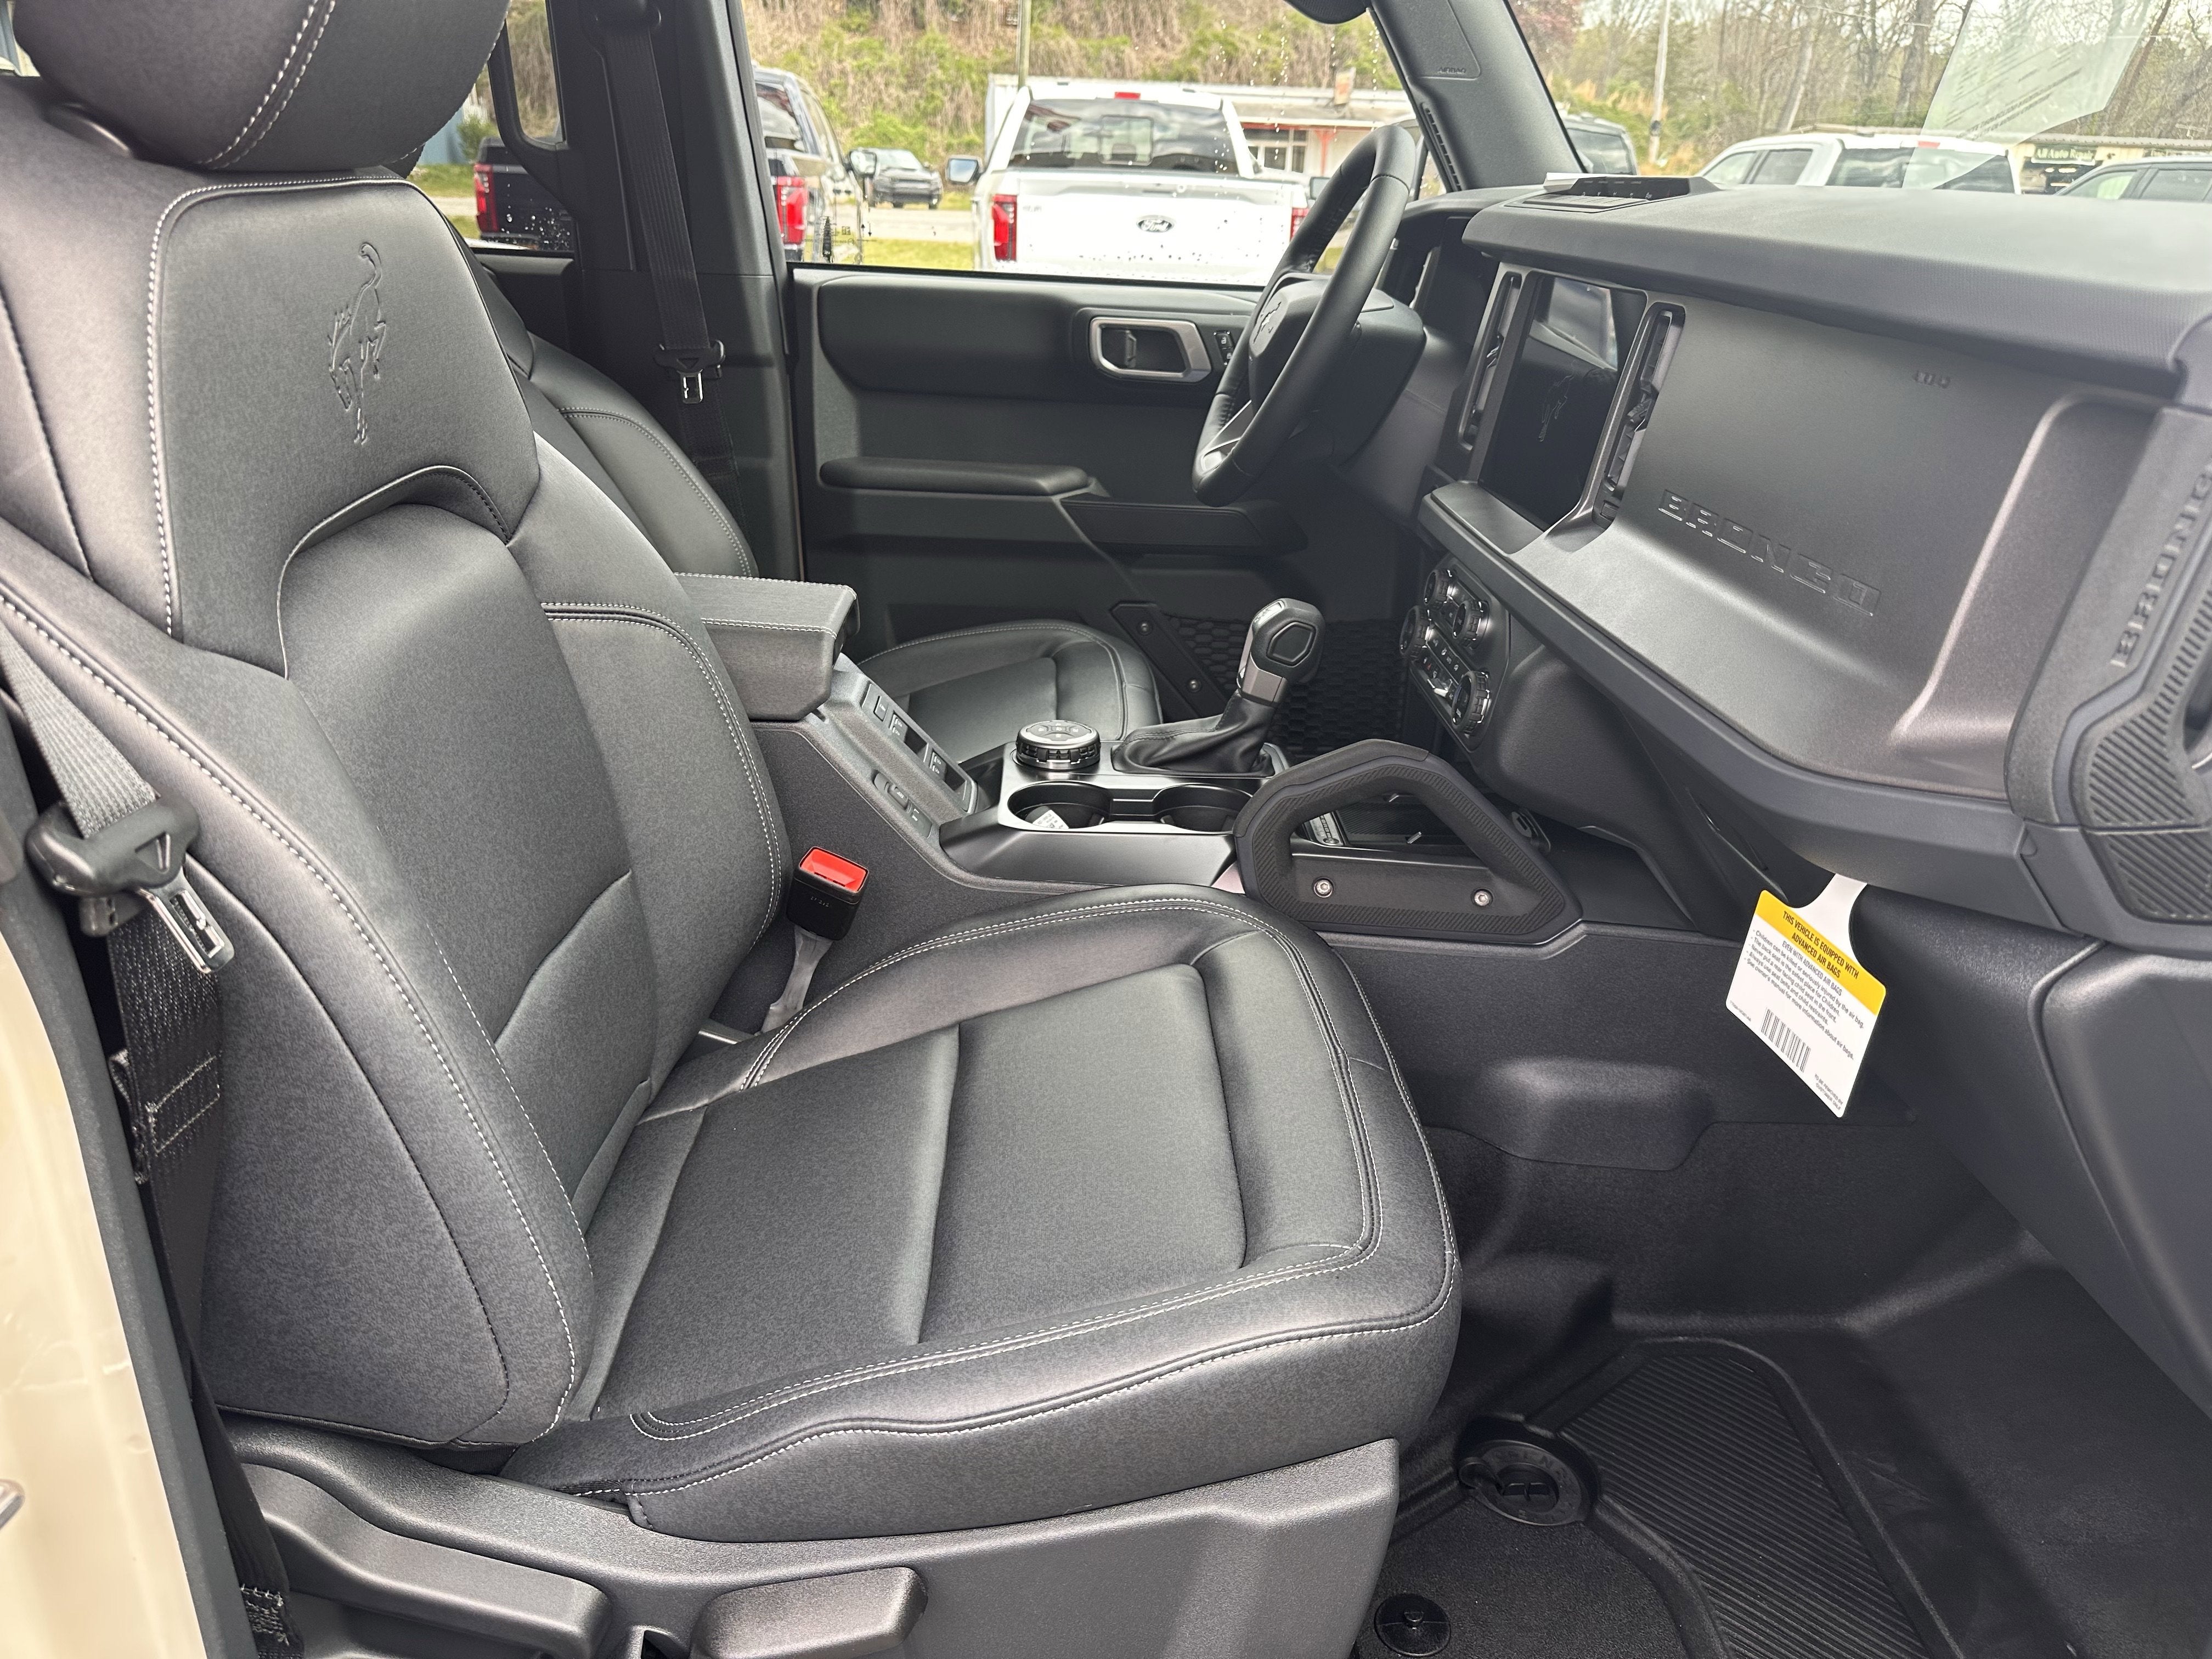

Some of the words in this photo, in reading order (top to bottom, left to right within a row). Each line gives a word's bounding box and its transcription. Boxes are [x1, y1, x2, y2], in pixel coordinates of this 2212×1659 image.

[2049, 148, 2069, 159] Auto
[1658, 489, 1882, 617] BRONCO
[2110, 453, 2212, 668] BRONC
[1749, 952, 1763, 966] Always
[1752, 944, 1763, 957] Never
[1782, 970, 1795, 985] facing
[1756, 930, 1773, 947] Children
[1786, 955, 1797, 968] killed
[1802, 970, 1820, 989] seriously
[1821, 985, 1836, 1001] injured
[1836, 998, 1841, 1008] by
[1782, 941, 1793, 953] EVEN
[1793, 949, 1803, 962] WITH
[1803, 959, 1823, 979] ADVANCED
[1831, 983, 1842, 996] BAGS
[1783, 911, 1795, 925] THIS
[1795, 920, 1814, 941] VEHICLE
[1814, 936, 1820, 946] IS
[1820, 941, 1844, 966] EQUIPPED
[1845, 962, 1859, 979] WITH
[1792, 933, 1817, 958] ADVANCED
[1817, 954, 1826, 966] AIR
[1826, 961, 1841, 978] BAGS
[1792, 970, 1804, 983] safest
[1804, 981, 1815, 993] place
[1771, 979, 1785, 995] manual
[1802, 1007, 1824, 1031] information
[1825, 1029, 1837, 1042] about
